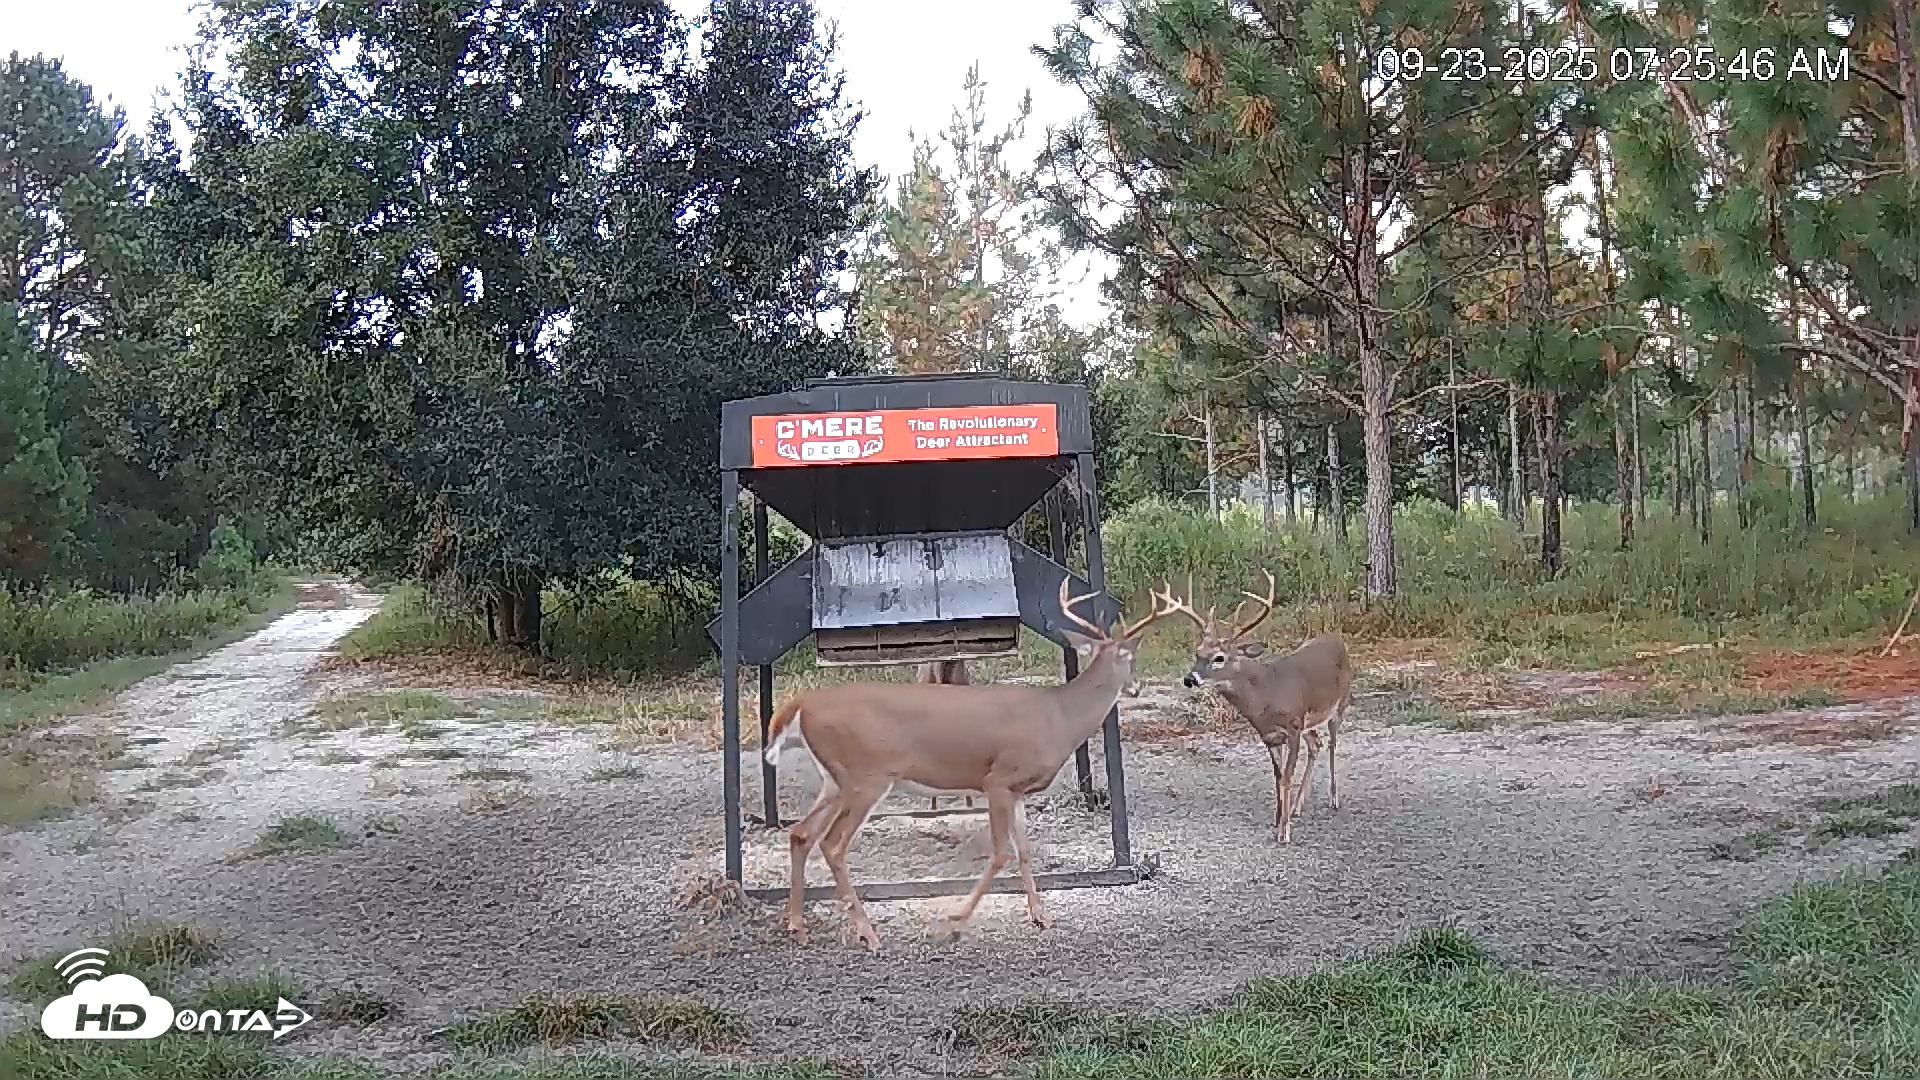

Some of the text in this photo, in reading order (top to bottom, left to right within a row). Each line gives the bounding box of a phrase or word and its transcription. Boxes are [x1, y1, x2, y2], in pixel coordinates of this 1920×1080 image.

[776, 415, 884, 439] C'MERE
[908, 416, 1039, 432] The Revolutionary
[916, 433, 1029, 449] Deer Attractant
[806, 444, 856, 457] DEER
